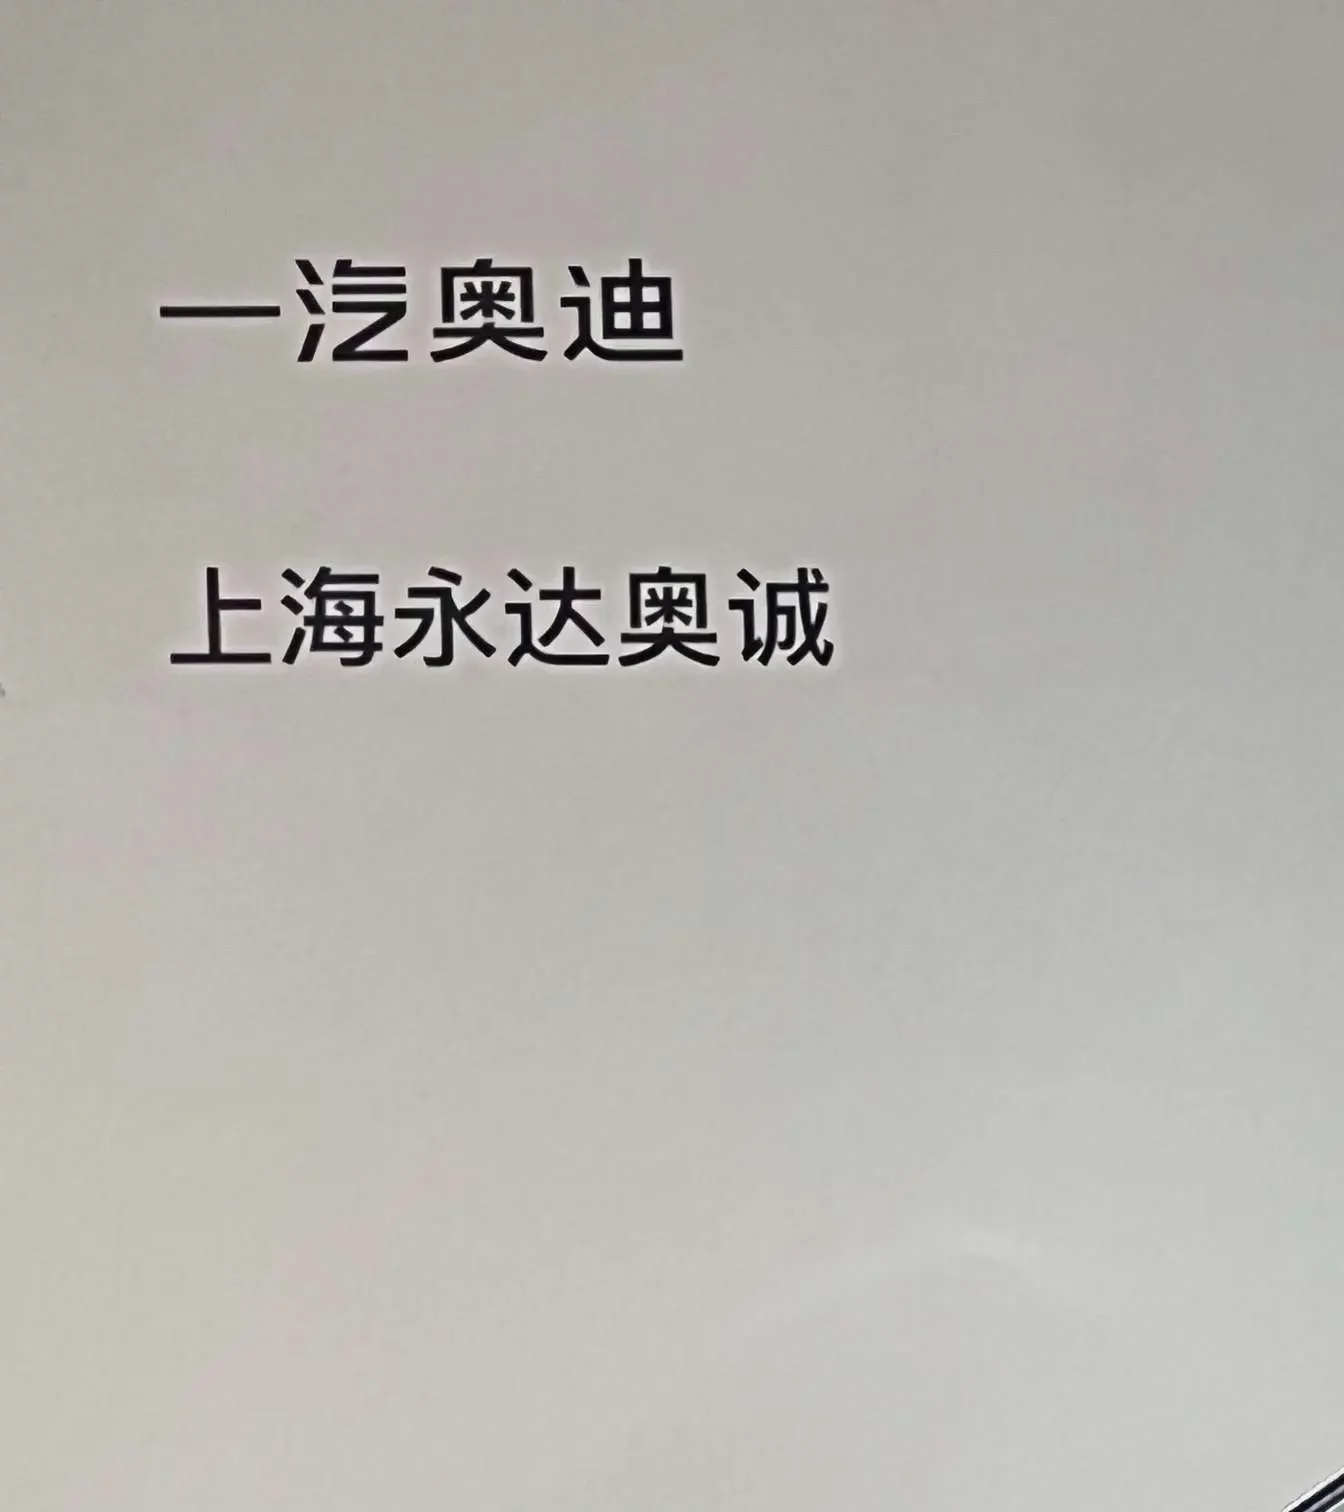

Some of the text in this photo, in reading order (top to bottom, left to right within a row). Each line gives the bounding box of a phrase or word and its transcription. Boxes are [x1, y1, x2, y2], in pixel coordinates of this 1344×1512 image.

[159, 258, 684, 363] 一汽奥迪
[169, 566, 835, 668] 上海永达奥诚
